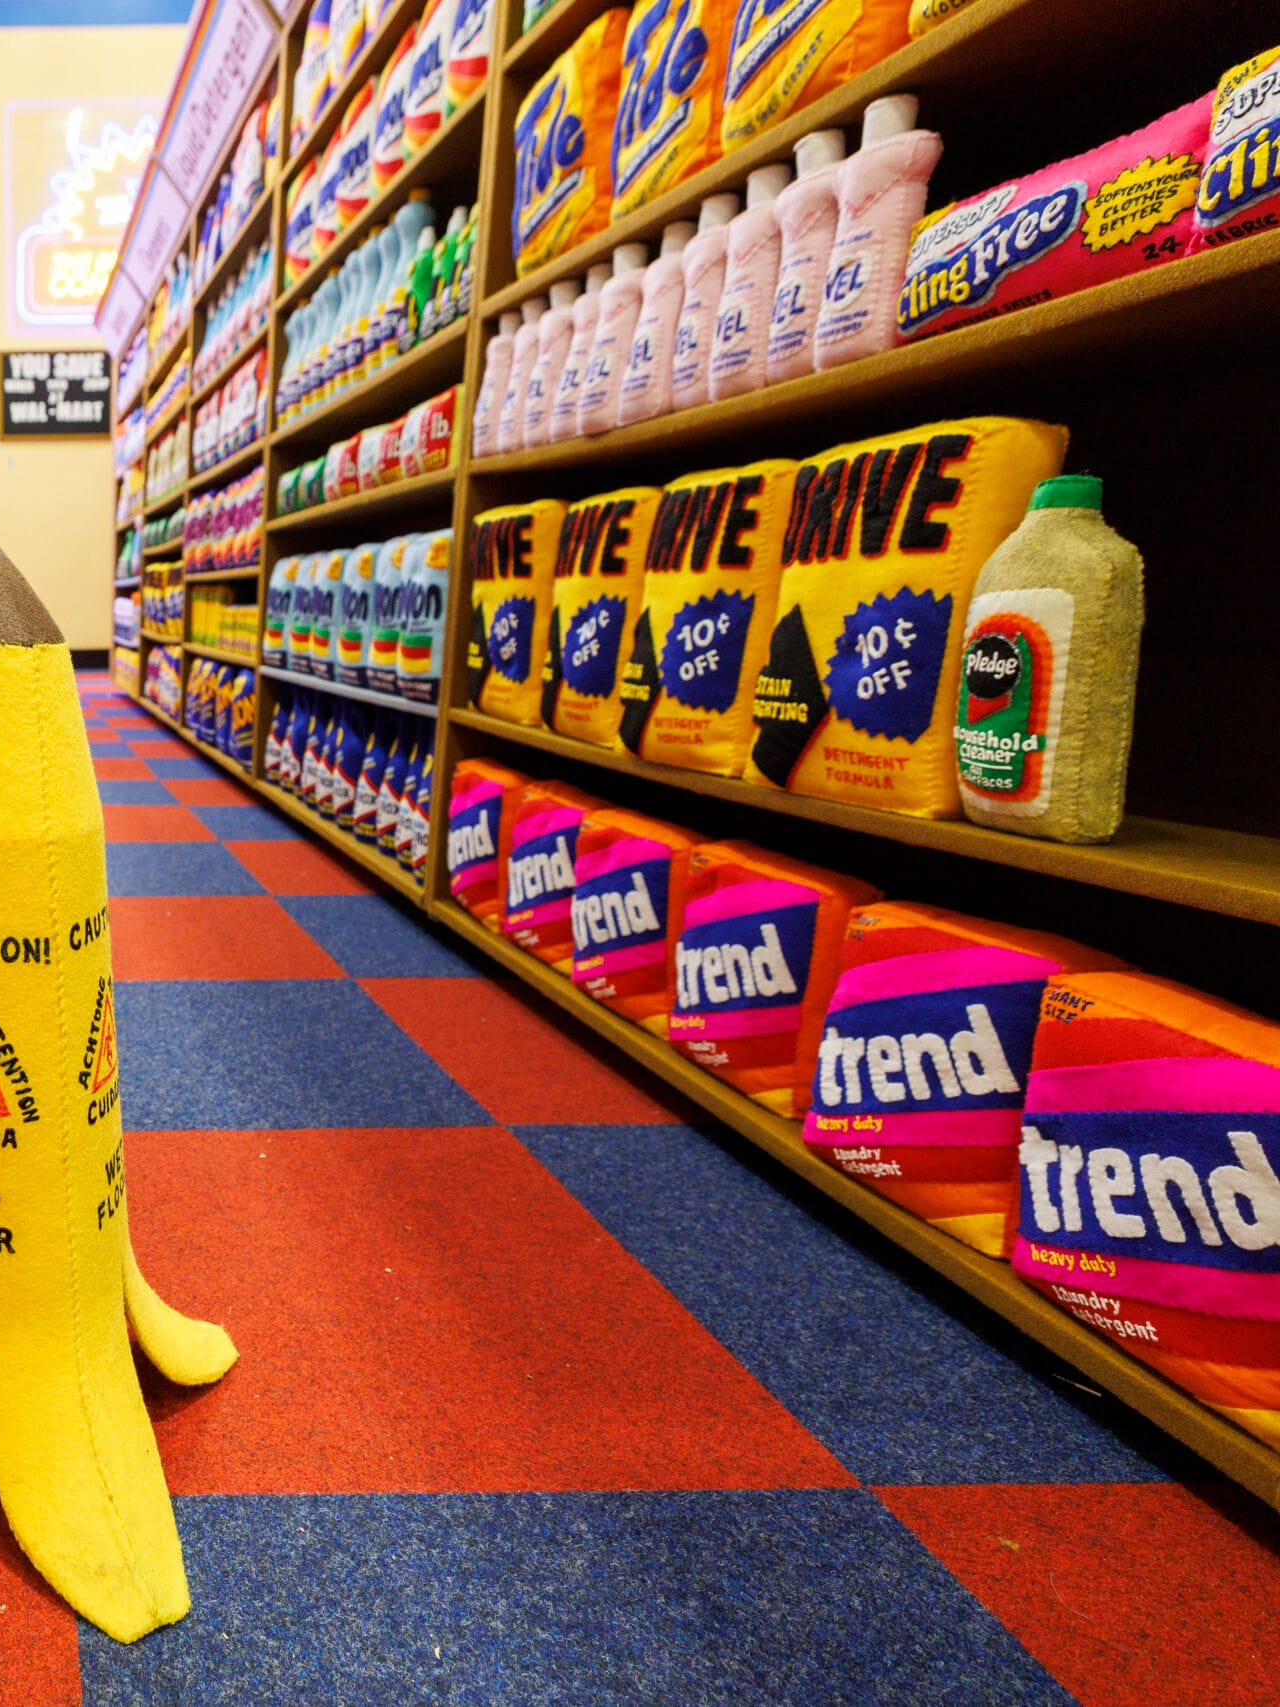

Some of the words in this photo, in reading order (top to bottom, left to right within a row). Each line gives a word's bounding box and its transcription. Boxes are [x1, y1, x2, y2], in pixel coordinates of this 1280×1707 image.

[1094, 179, 1153, 209] SOFTENS
[1102, 183, 1181, 219] CLOTHES
[1098, 201, 1164, 236] BETTER
[1205, 213, 1279, 246] FABRIC
[896, 253, 971, 325] Cling
[970, 194, 1068, 286] Free
[1141, 235, 1183, 261] 24
[825, 262, 864, 301] VEL
[9, 352, 51, 381] YOU
[53, 352, 105, 380] SAVE
[572, 639, 602, 668] OFF
[679, 649, 722, 682] OFF
[856, 659, 914, 700] OFF
[825, 765, 896, 792] FORMULA
[675, 917, 798, 1010] trend
[1044, 1004, 1077, 1025] SIZE
[819, 1003, 1021, 1107] trend
[1020, 1125, 1280, 1253] trend
[1030, 1243, 1075, 1272] heavy
[1078, 1252, 1117, 1278] duty
